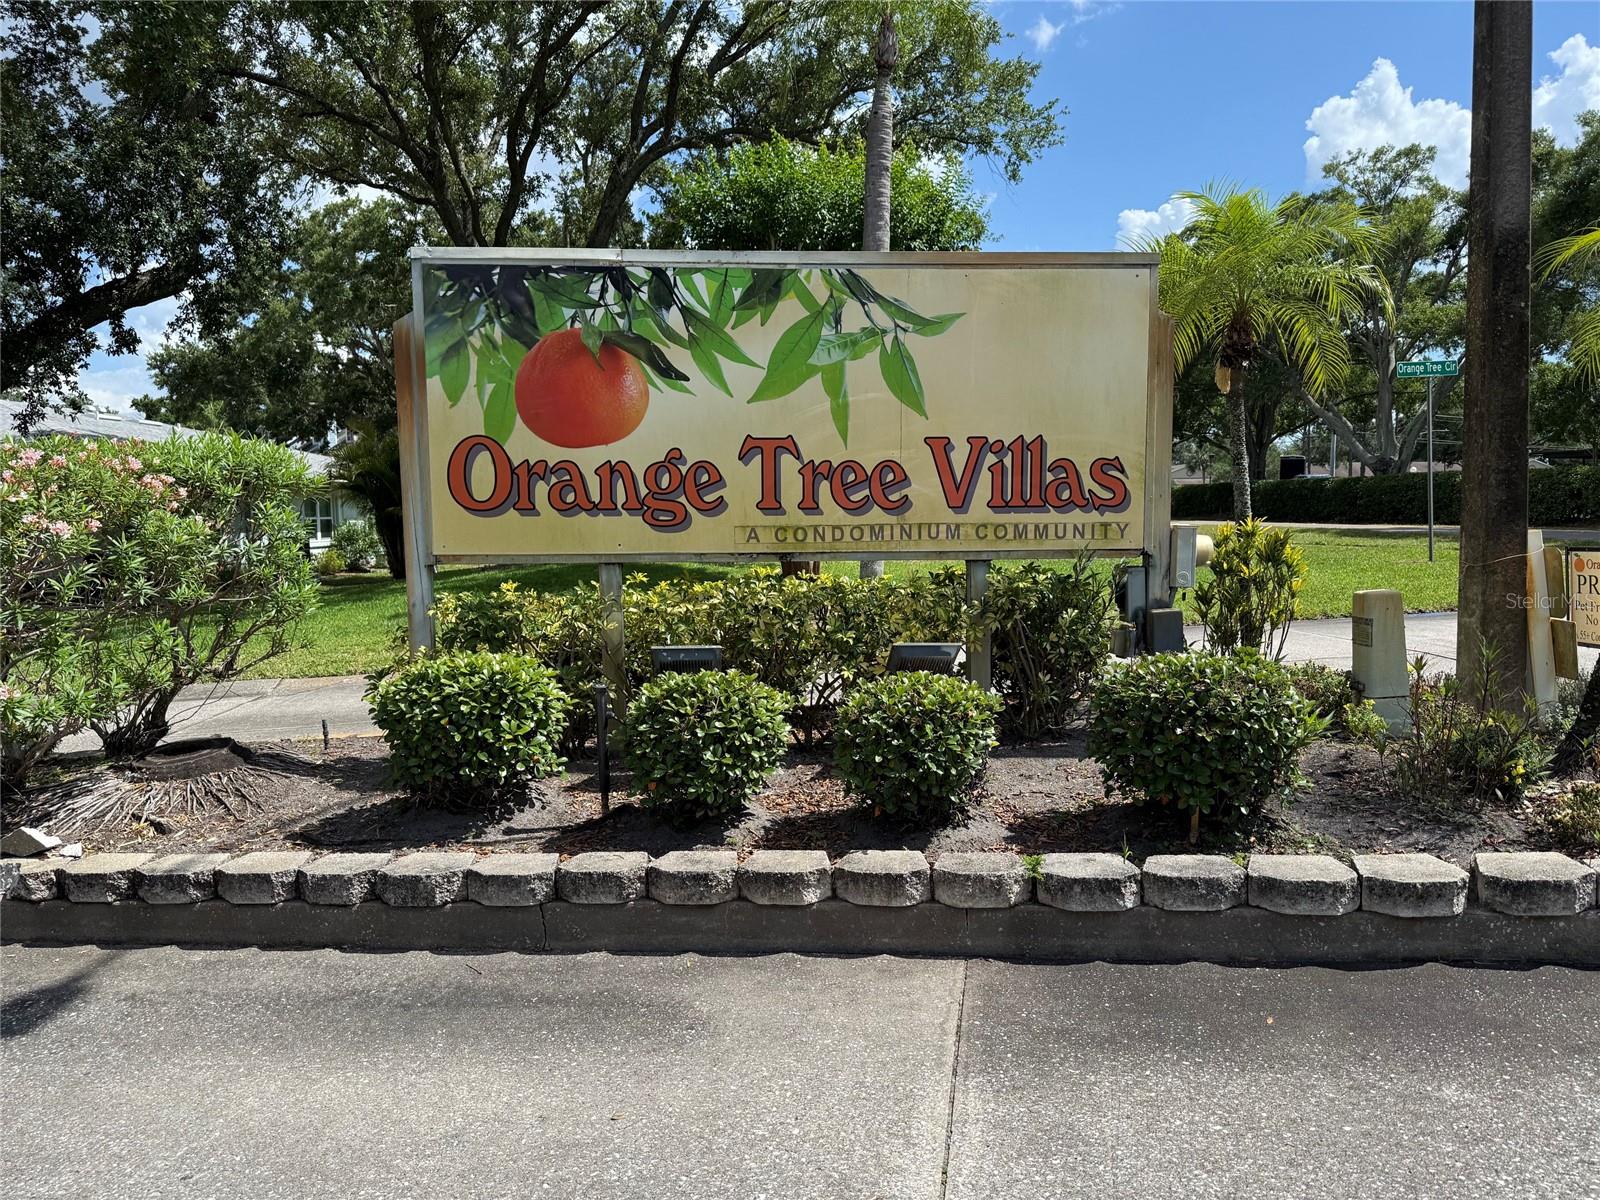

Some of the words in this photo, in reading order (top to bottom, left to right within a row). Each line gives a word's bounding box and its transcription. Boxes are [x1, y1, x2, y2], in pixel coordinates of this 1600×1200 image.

[1398, 363, 1424, 376] Orange
[1426, 362, 1442, 372] Tree
[1445, 361, 1456, 371] Cir
[447, 434, 728, 532] Orange
[738, 434, 911, 516] Tree
[924, 434, 1130, 516] Villas
[746, 527, 760, 543] A
[774, 523, 961, 543] CONDOMINIUM
[975, 523, 1129, 540] COMMUNITY
[1577, 574, 1600, 595] PR
[1586, 613, 1599, 625] No
